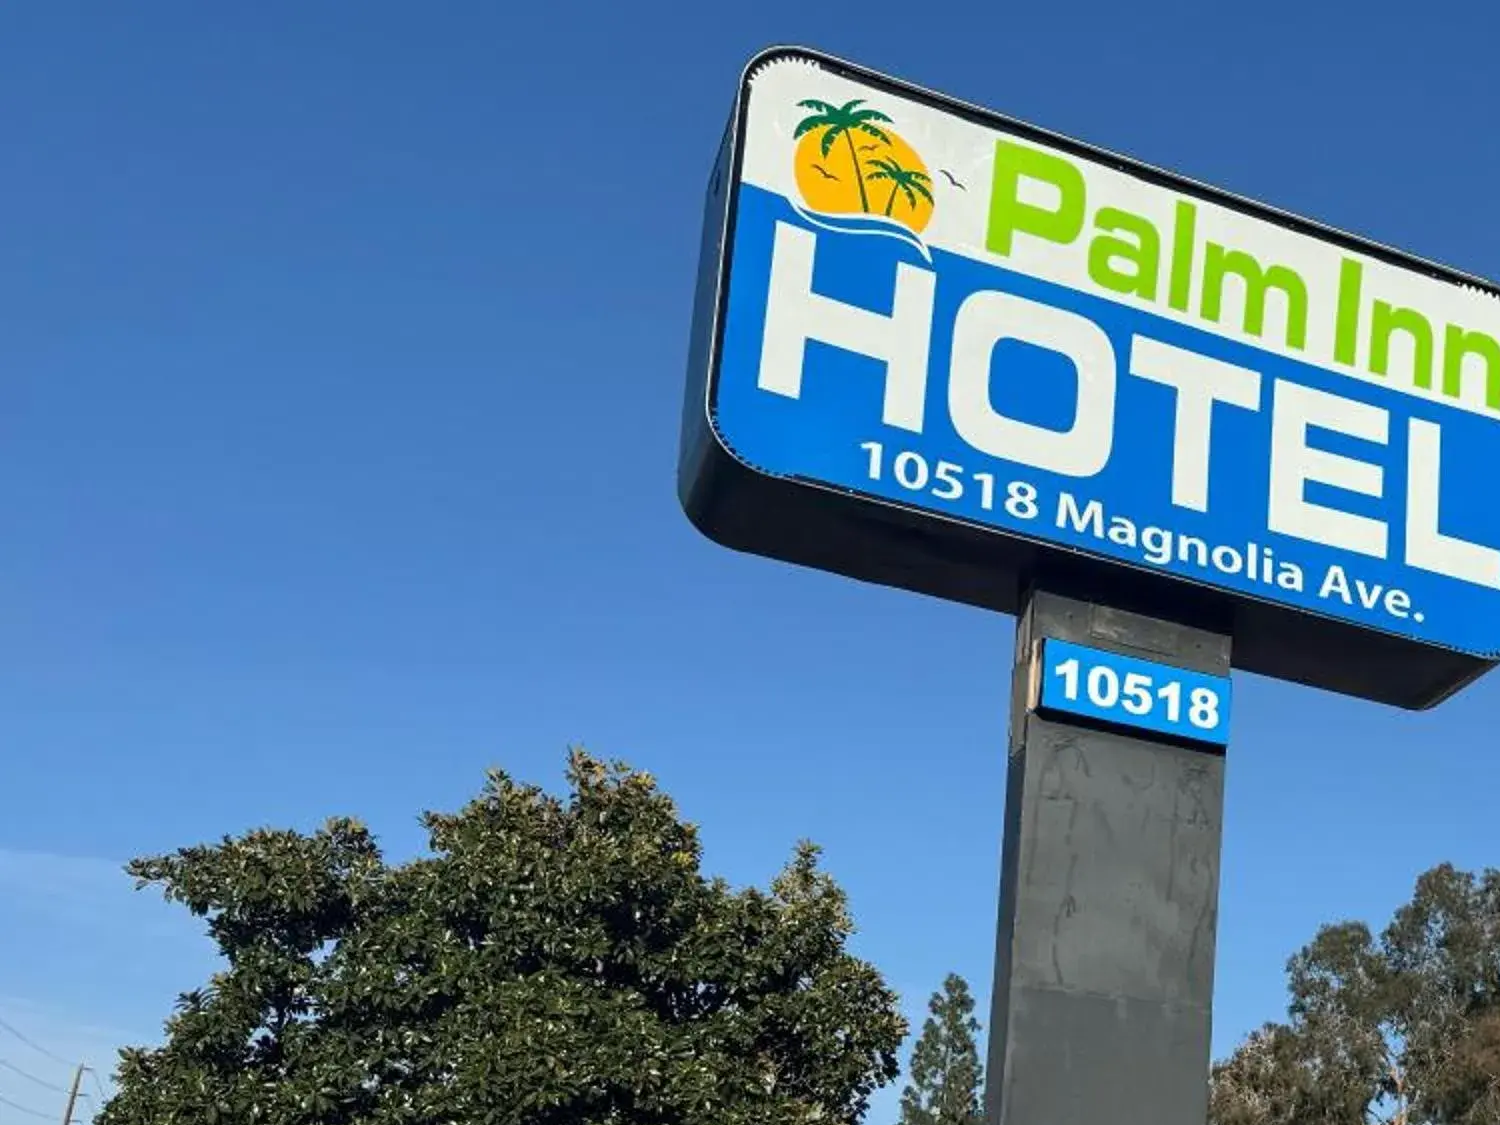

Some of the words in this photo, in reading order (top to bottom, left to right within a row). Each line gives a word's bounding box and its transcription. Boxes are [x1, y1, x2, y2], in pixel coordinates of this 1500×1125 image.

[985, 139, 1308, 351] Palm
[860, 441, 1039, 520] 10518
[1055, 492, 1304, 592] Magnolia
[1319, 564, 1426, 623] Ave.
[1055, 658, 1219, 730] 10518
